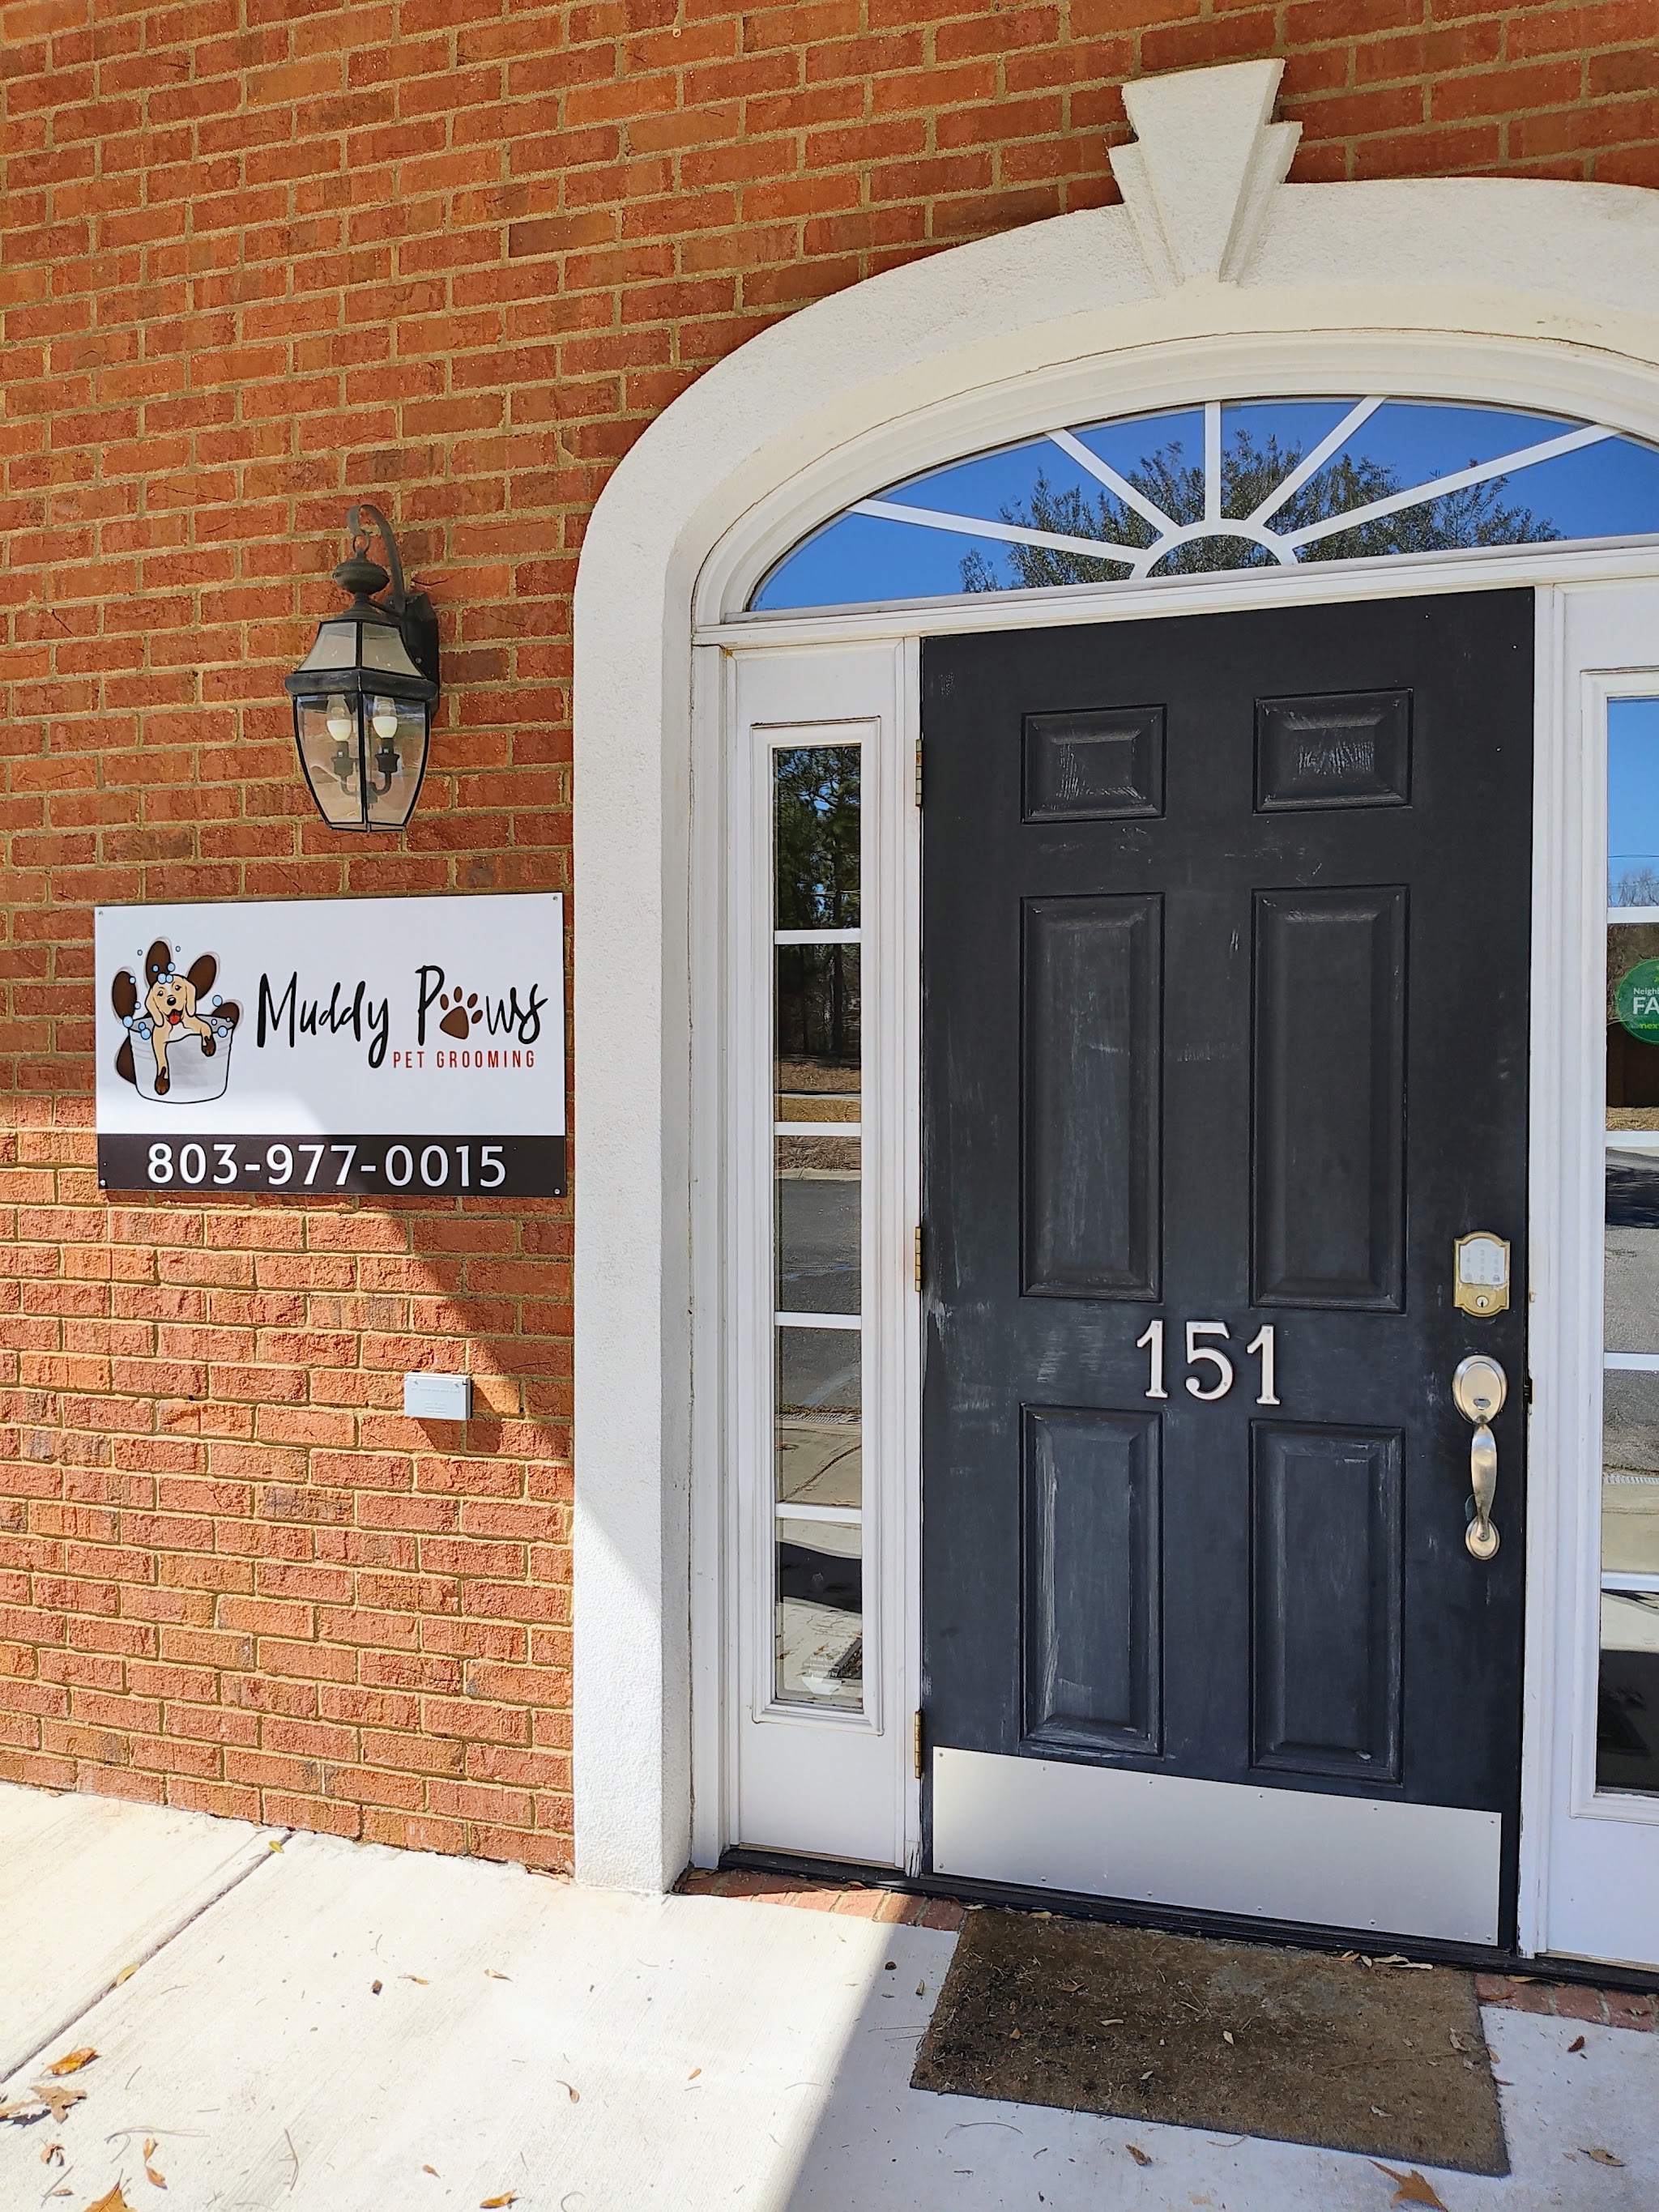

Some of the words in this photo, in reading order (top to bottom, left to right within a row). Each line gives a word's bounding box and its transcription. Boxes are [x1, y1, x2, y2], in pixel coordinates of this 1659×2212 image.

[258, 972, 389, 1068] Muddy
[393, 1051, 423, 1068] PET
[437, 1051, 535, 1068] GROOMING
[148, 1143, 506, 1188] 803-977-0015
[1137, 1319, 1281, 1405] 151
